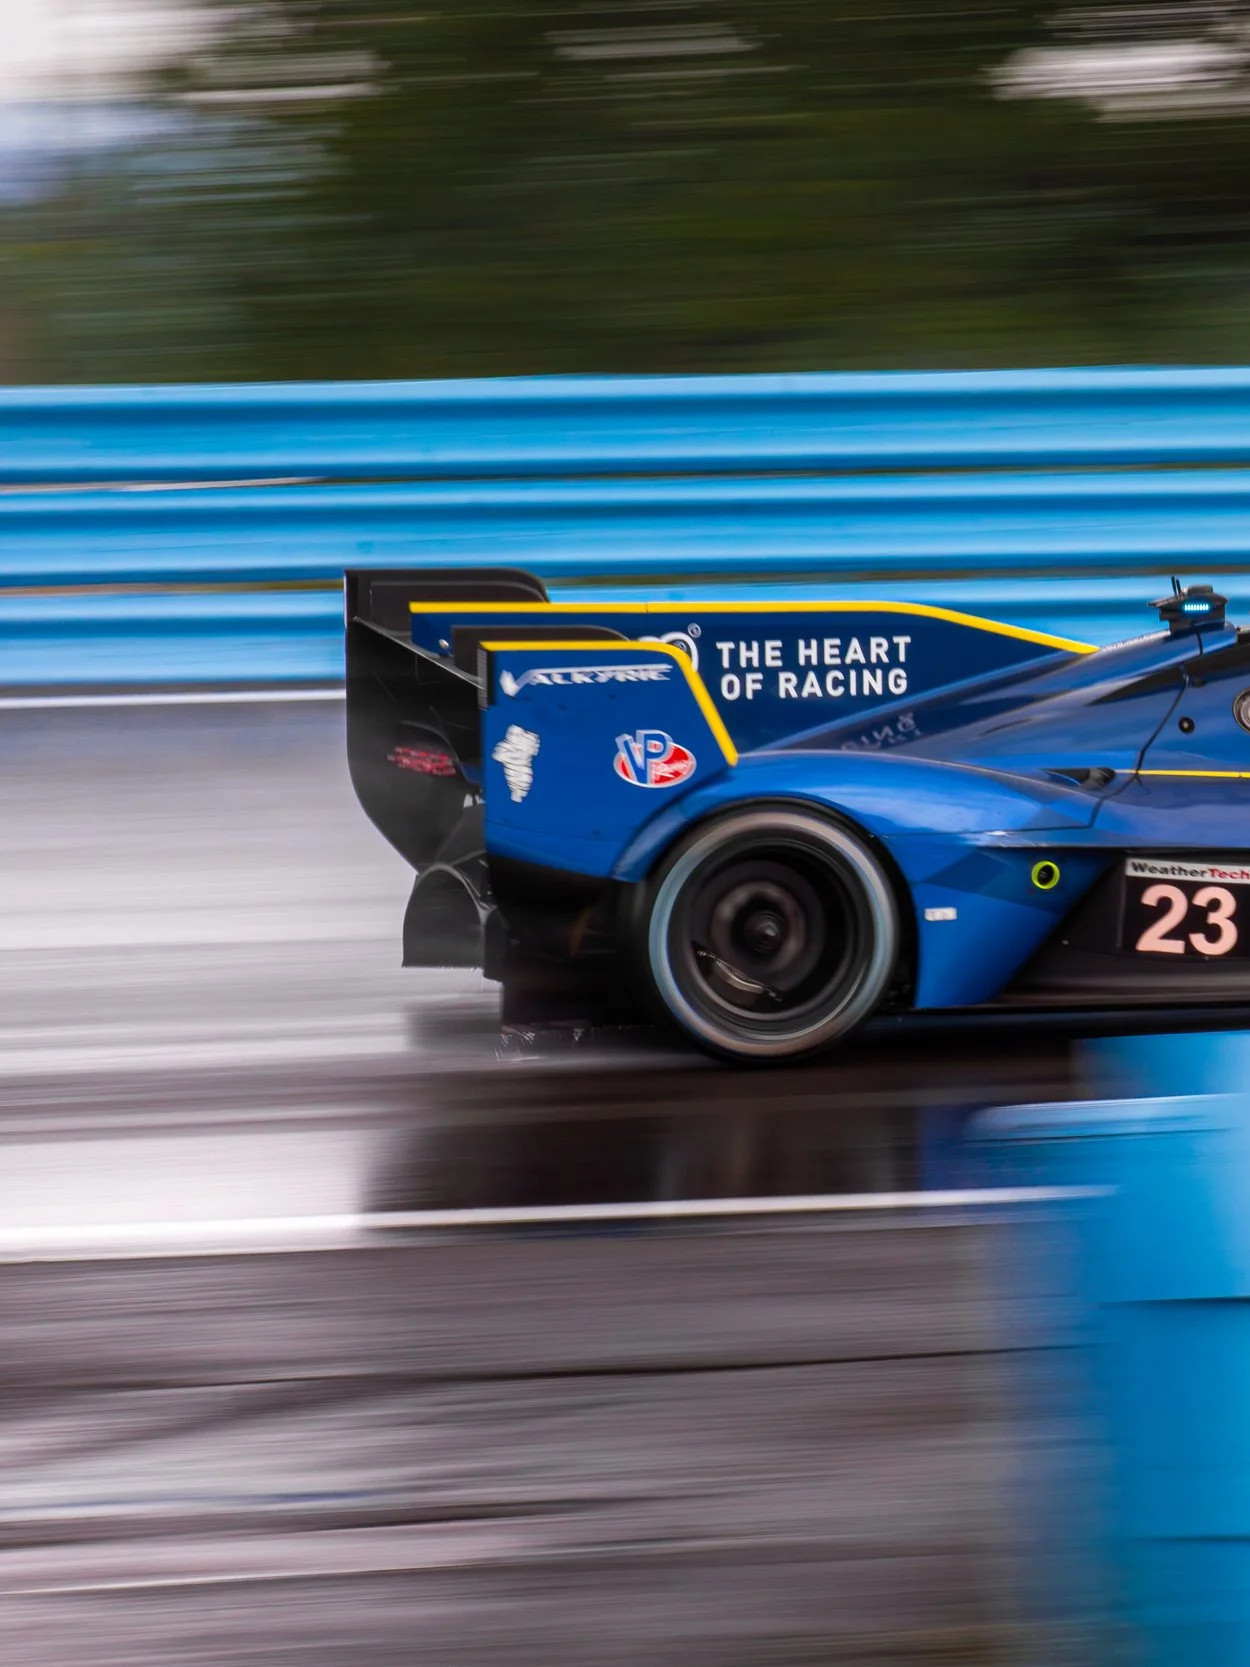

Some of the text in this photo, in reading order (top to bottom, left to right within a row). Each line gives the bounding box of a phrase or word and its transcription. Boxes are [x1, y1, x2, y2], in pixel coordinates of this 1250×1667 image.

[716, 636, 911, 669] THE HEART
[499, 663, 674, 698] VALKYRIE
[720, 669, 908, 700] OF RACING
[614, 729, 673, 784] VP
[1131, 861, 1250, 880] WeatherTech
[1135, 884, 1238, 955] 23
